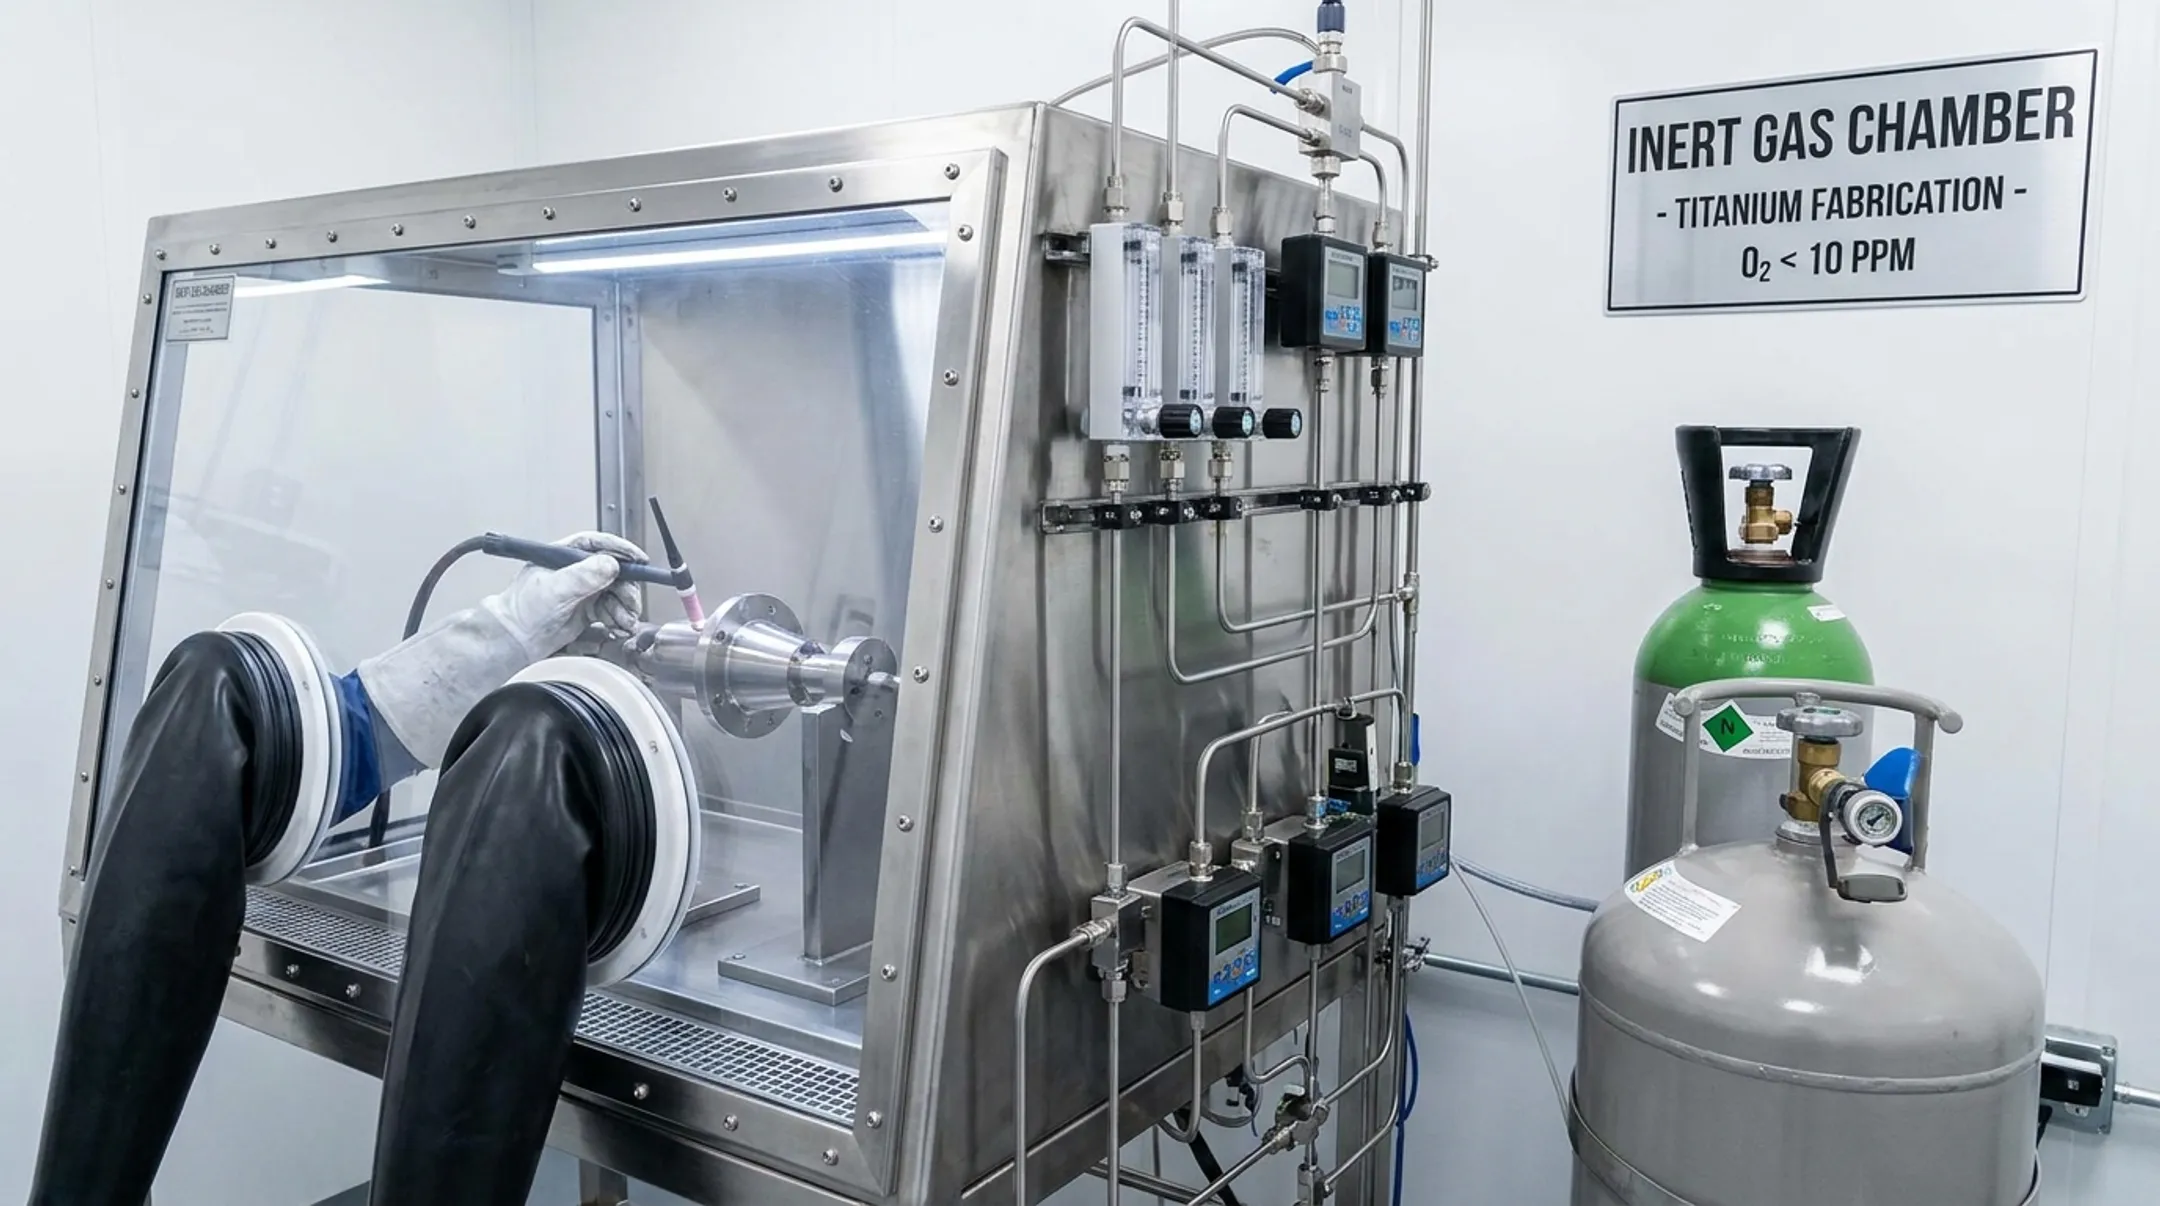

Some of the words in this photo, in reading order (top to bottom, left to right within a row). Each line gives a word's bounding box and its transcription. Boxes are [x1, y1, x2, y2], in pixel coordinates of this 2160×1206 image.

[1627, 116, 1742, 174] INERT
[1753, 108, 1835, 164] GAS
[1847, 86, 2075, 156] CHAMBER
[1674, 189, 1803, 229] TITANIUM
[1811, 175, 2004, 222] FABRICATION
[1780, 251, 1797, 268] <
[1810, 240, 1843, 275] 10
[1851, 237, 1916, 274] PPM
